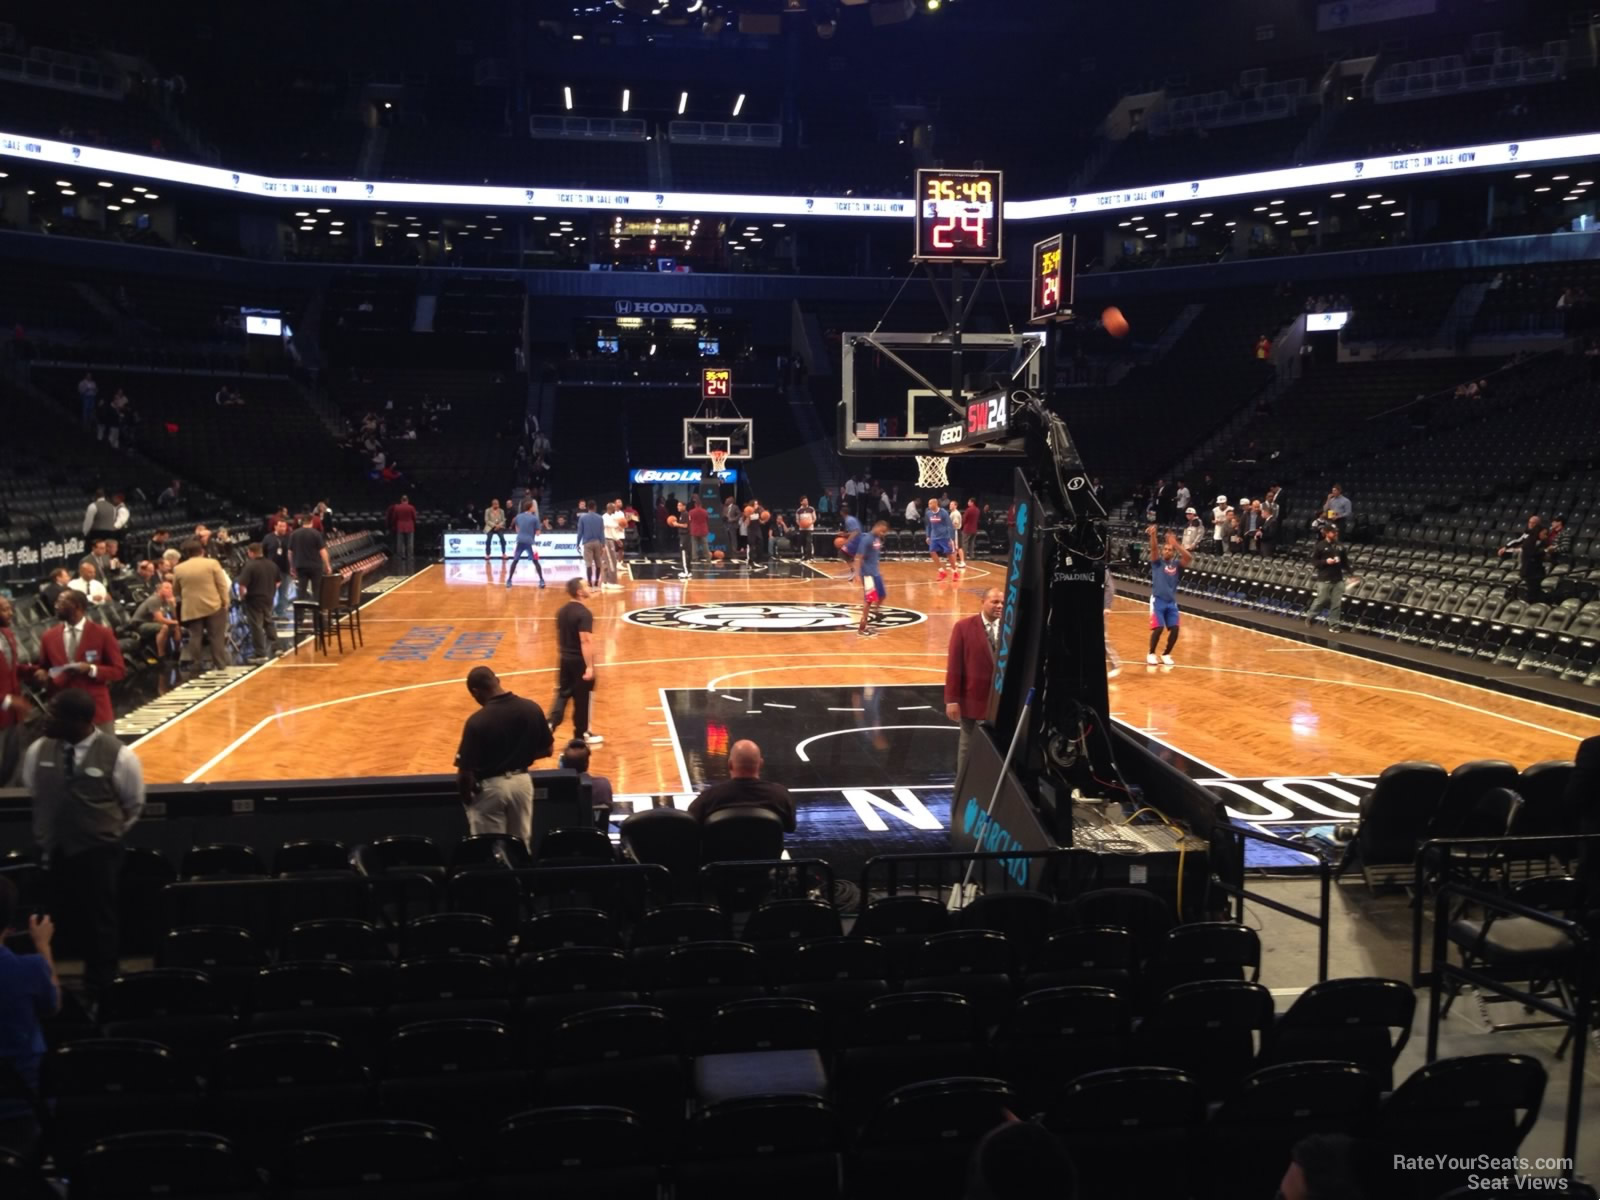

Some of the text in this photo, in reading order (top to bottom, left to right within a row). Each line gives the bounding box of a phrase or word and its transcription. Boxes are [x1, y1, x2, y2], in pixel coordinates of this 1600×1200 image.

[928, 180, 992, 203] 35:49
[1044, 277, 1060, 305] 24
[633, 302, 708, 314] HONDA
[707, 381, 727, 395] 24
[940, 425, 963, 446] GEICO
[1053, 571, 1096, 583] SPALDING
[995, 540, 1024, 694] BARCLAYS
